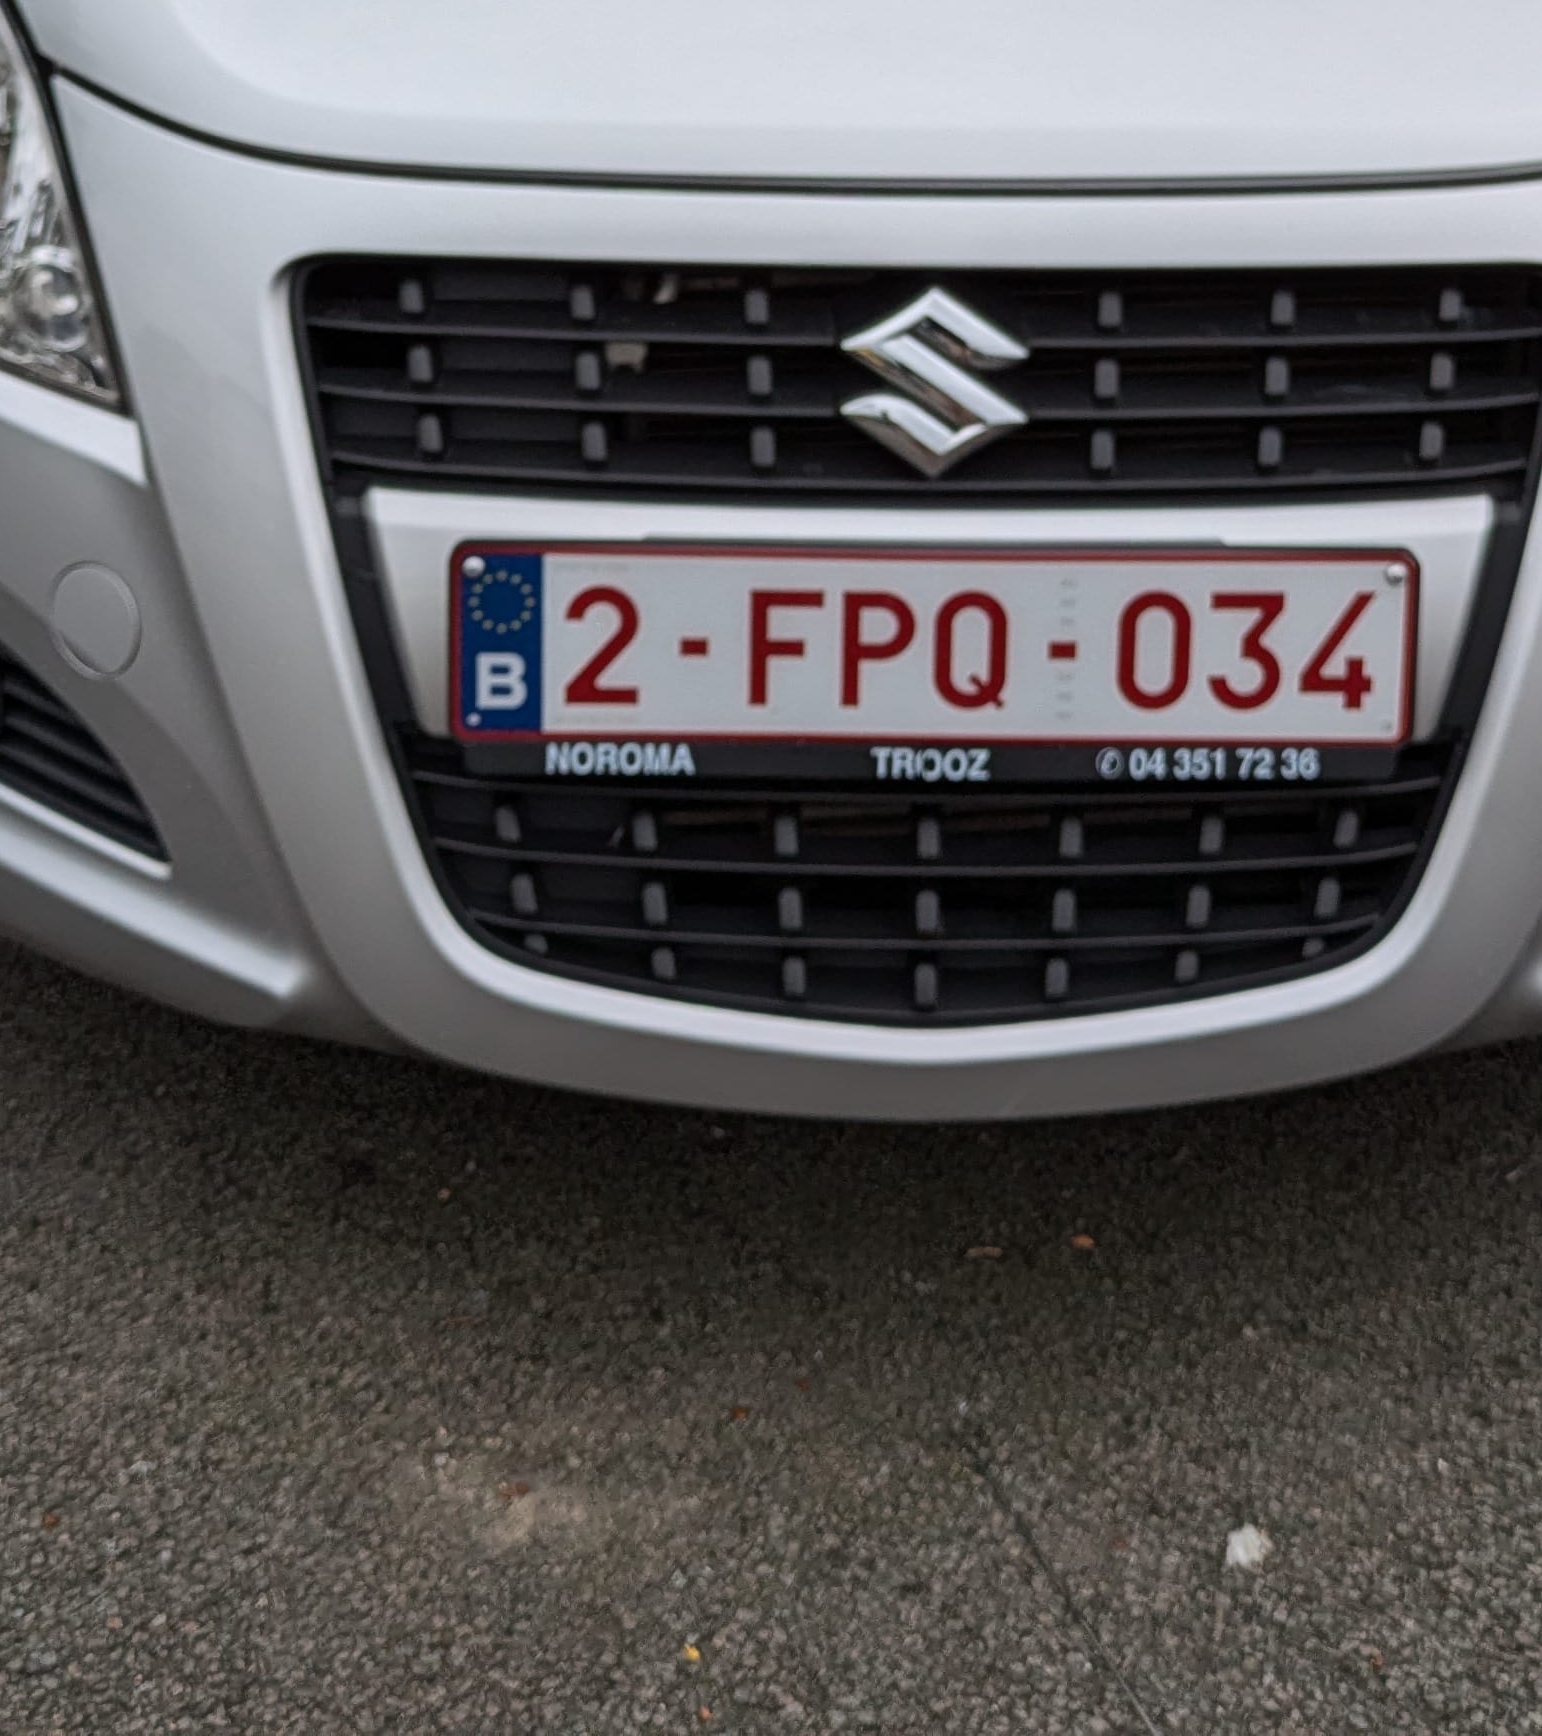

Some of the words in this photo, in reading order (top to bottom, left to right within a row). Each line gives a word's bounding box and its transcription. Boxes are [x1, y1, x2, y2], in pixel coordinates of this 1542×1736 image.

[563, 585, 1376, 711] 2-FPQ-034
[475, 654, 528, 710] B
[545, 741, 695, 776] NOROMA
[870, 746, 991, 782] TROOZ
[1129, 747, 1168, 780] 04
[1173, 747, 1225, 780] 351
[1235, 747, 1275, 780] 72
